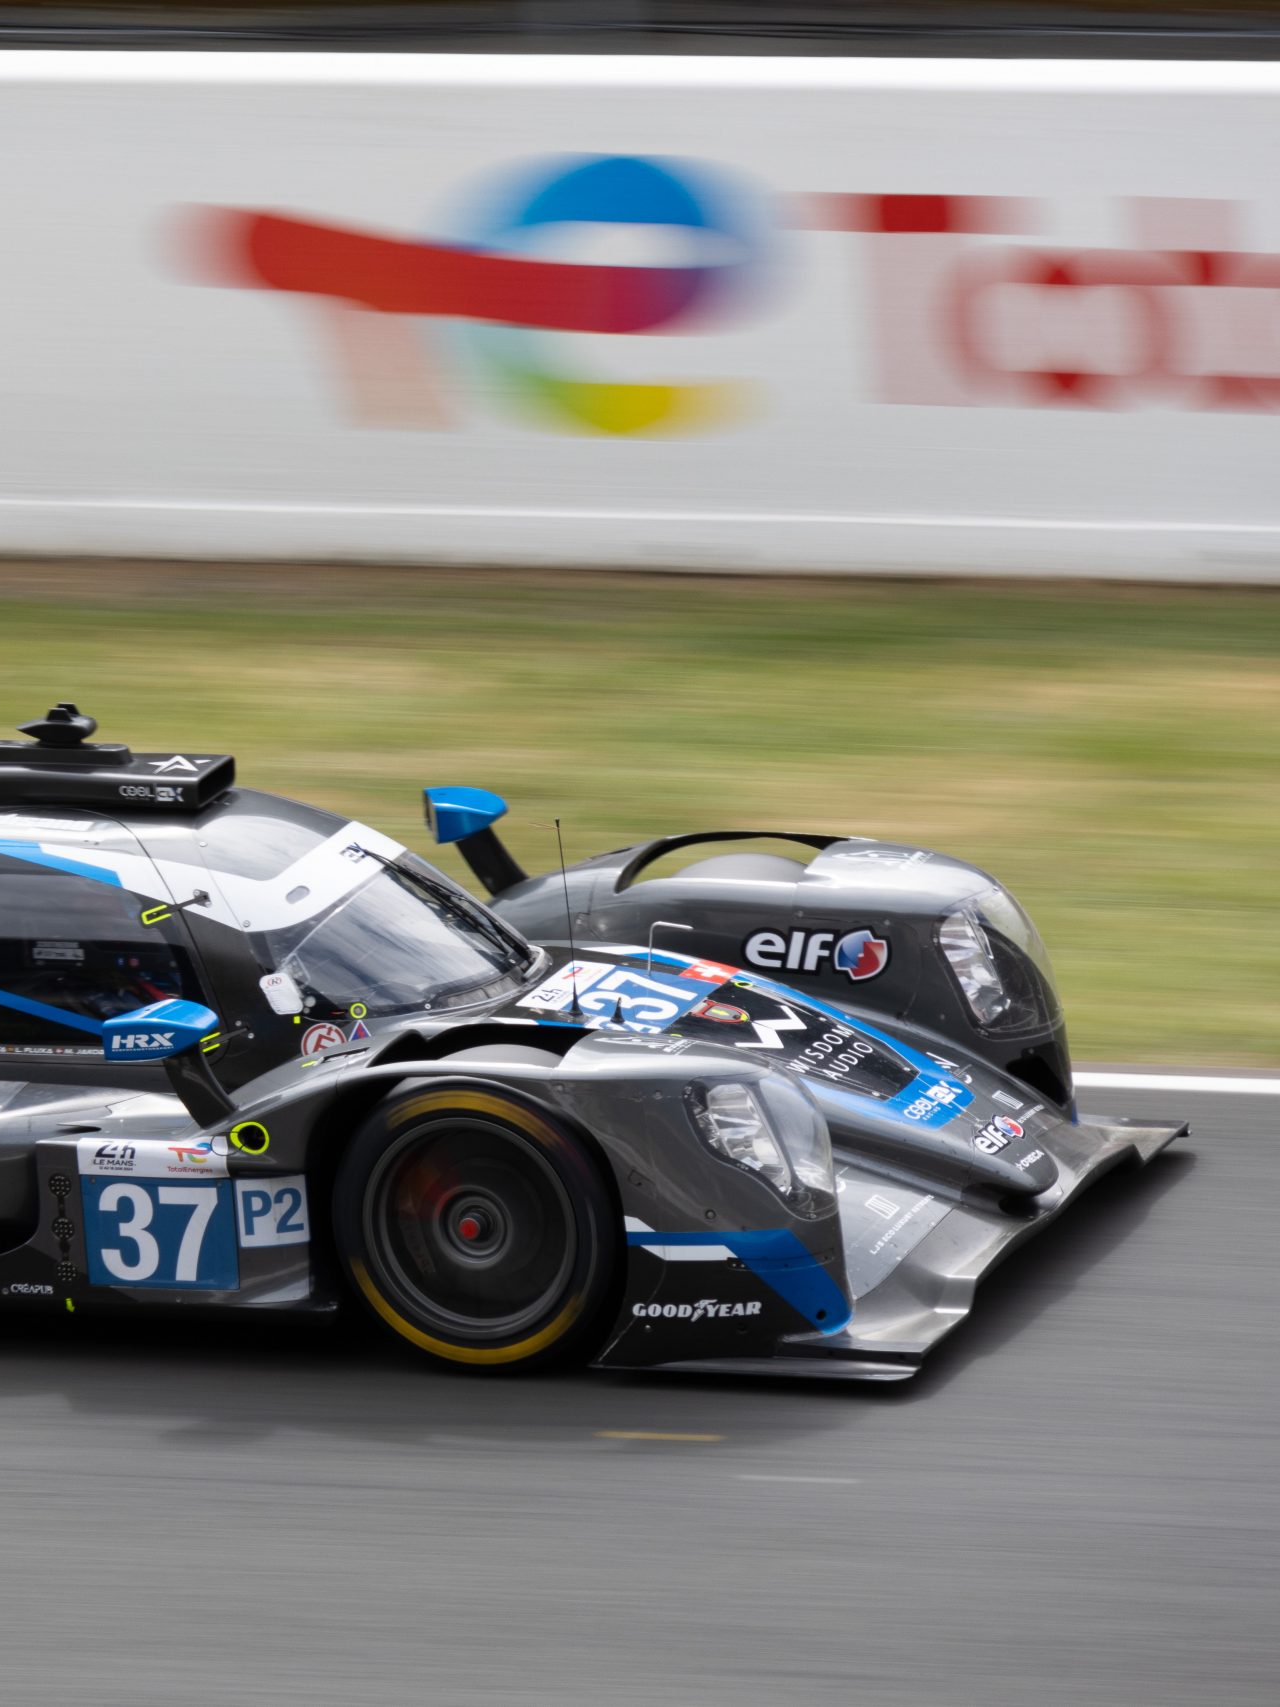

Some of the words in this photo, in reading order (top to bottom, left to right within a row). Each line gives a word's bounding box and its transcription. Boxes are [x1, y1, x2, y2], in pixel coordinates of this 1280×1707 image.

[745, 931, 835, 971] elf
[580, 970, 699, 1021] 37
[112, 1032, 176, 1048] HRX
[785, 1024, 856, 1074] WISDOM
[822, 1041, 874, 1081] AUDIO
[974, 1124, 1007, 1156] elf
[93, 1158, 105, 1166] LE
[106, 1159, 134, 1167] MANS
[167, 1166, 213, 1174] TotalEnergies
[98, 1182, 219, 1282] 37
[241, 1187, 306, 1237] P2
[631, 1299, 762, 1322] GOODYEAR
